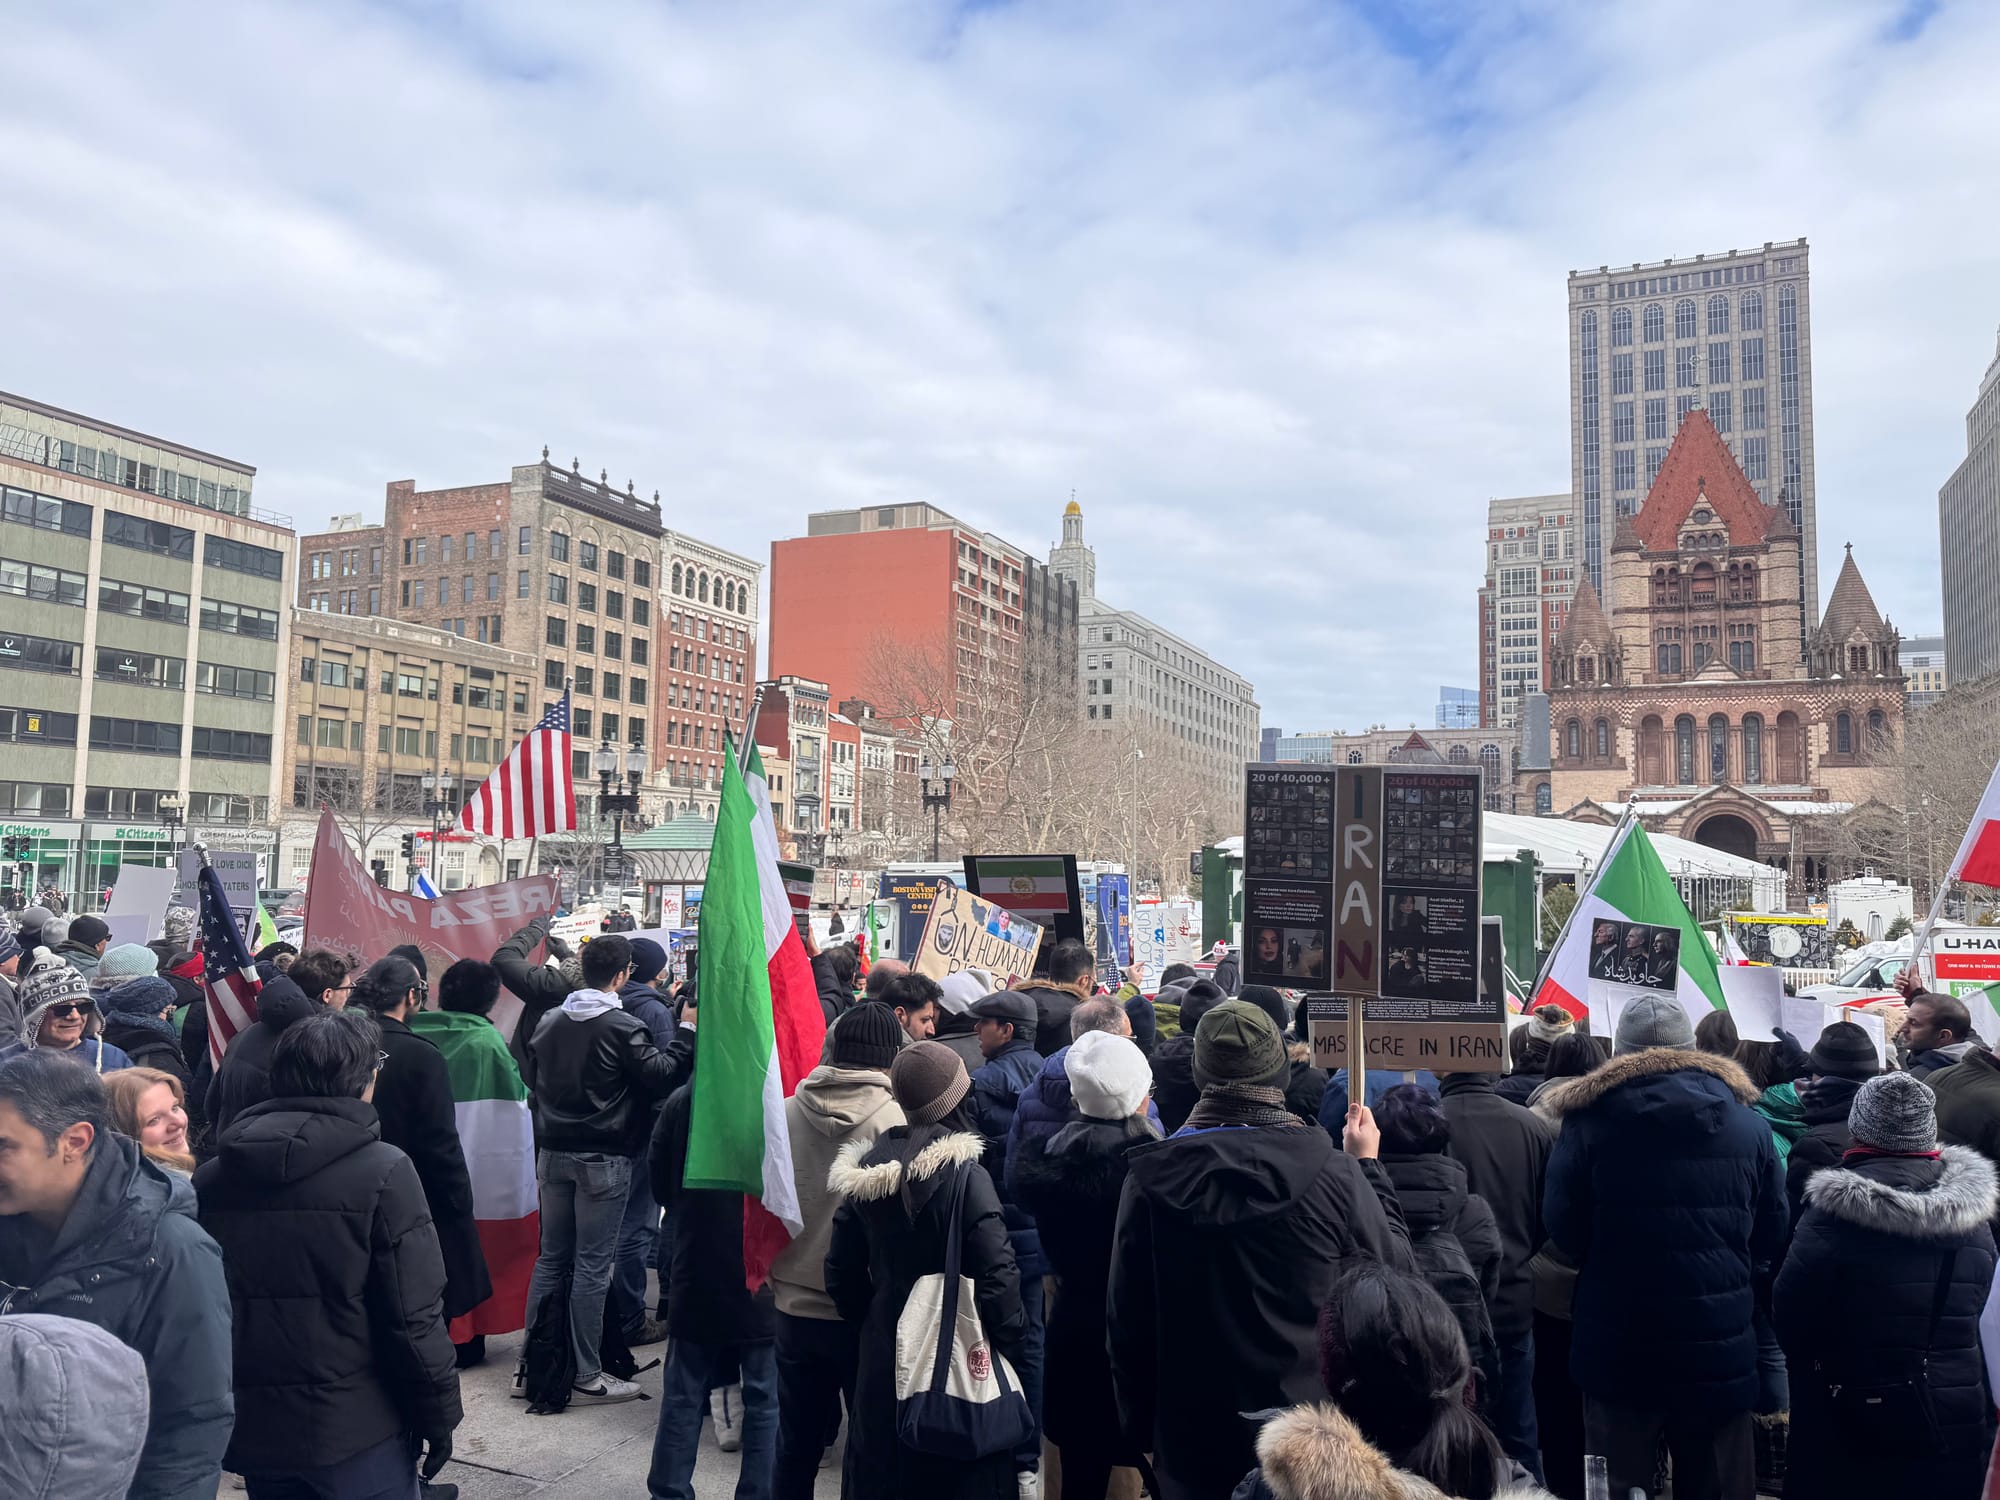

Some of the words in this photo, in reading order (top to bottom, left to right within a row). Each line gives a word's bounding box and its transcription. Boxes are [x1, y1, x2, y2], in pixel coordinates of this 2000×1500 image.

[1252, 774, 1266, 783] 20
[1267, 774, 1280, 783] of
[1281, 774, 1322, 785] 40,000
[1389, 776, 1404, 786] 20
[1405, 777, 1418, 786] of
[1419, 777, 1464, 788] 40,000
[5, 825, 51, 837] Citizens
[126, 828, 166, 840] Citizens
[216, 860, 235, 870] LOVE
[838, 872, 862, 888] FedEx
[1337, 774, 1375, 981] IRAN
[907, 892, 935, 900] CENTER
[575, 919, 596, 927] REJECT
[975, 934, 1034, 978] HUMAN
[28, 985, 69, 1008] CUSCO
[1313, 1034, 1405, 1057] MASCRE
[1419, 1037, 1438, 1057] IN
[1450, 1035, 1504, 1059] IRAN
